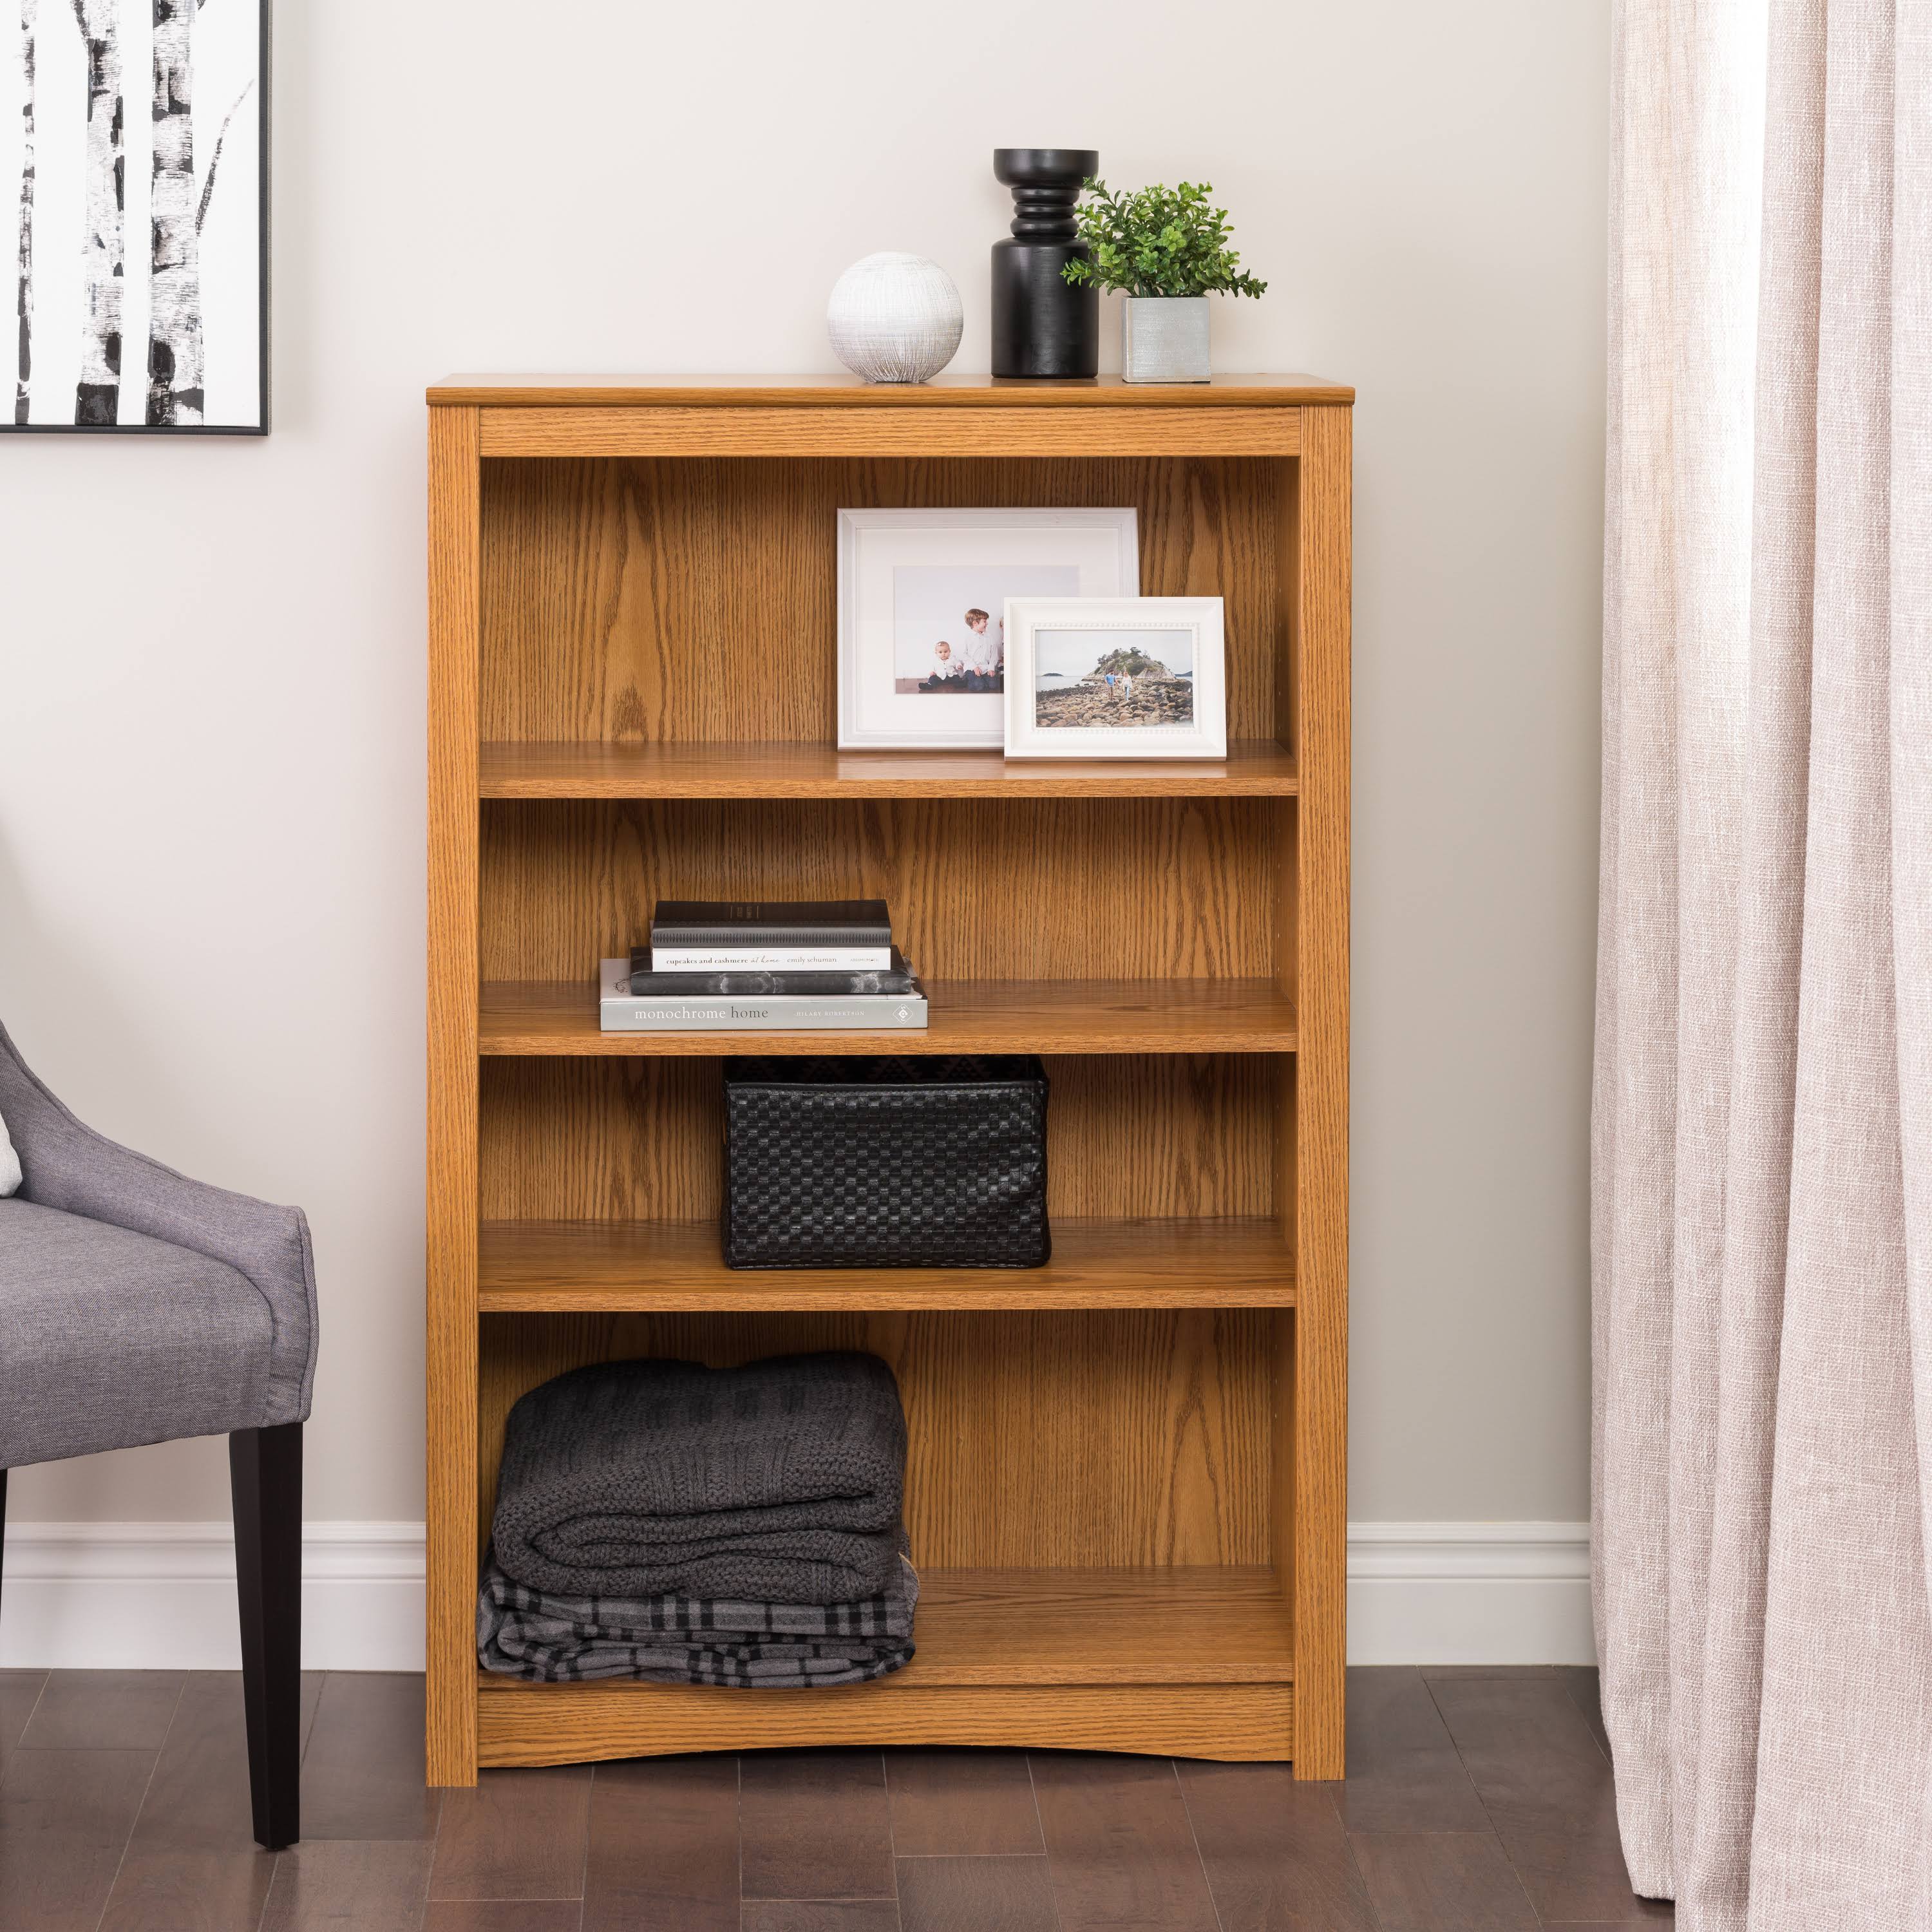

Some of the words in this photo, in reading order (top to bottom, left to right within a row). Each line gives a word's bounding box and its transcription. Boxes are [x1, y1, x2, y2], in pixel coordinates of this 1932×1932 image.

[666, 958, 697, 966] cupcakes
[761, 955, 780, 963] home
[787, 956, 806, 965] emily
[634, 1006, 726, 1019] monochrome
[731, 1006, 768, 1018] home
